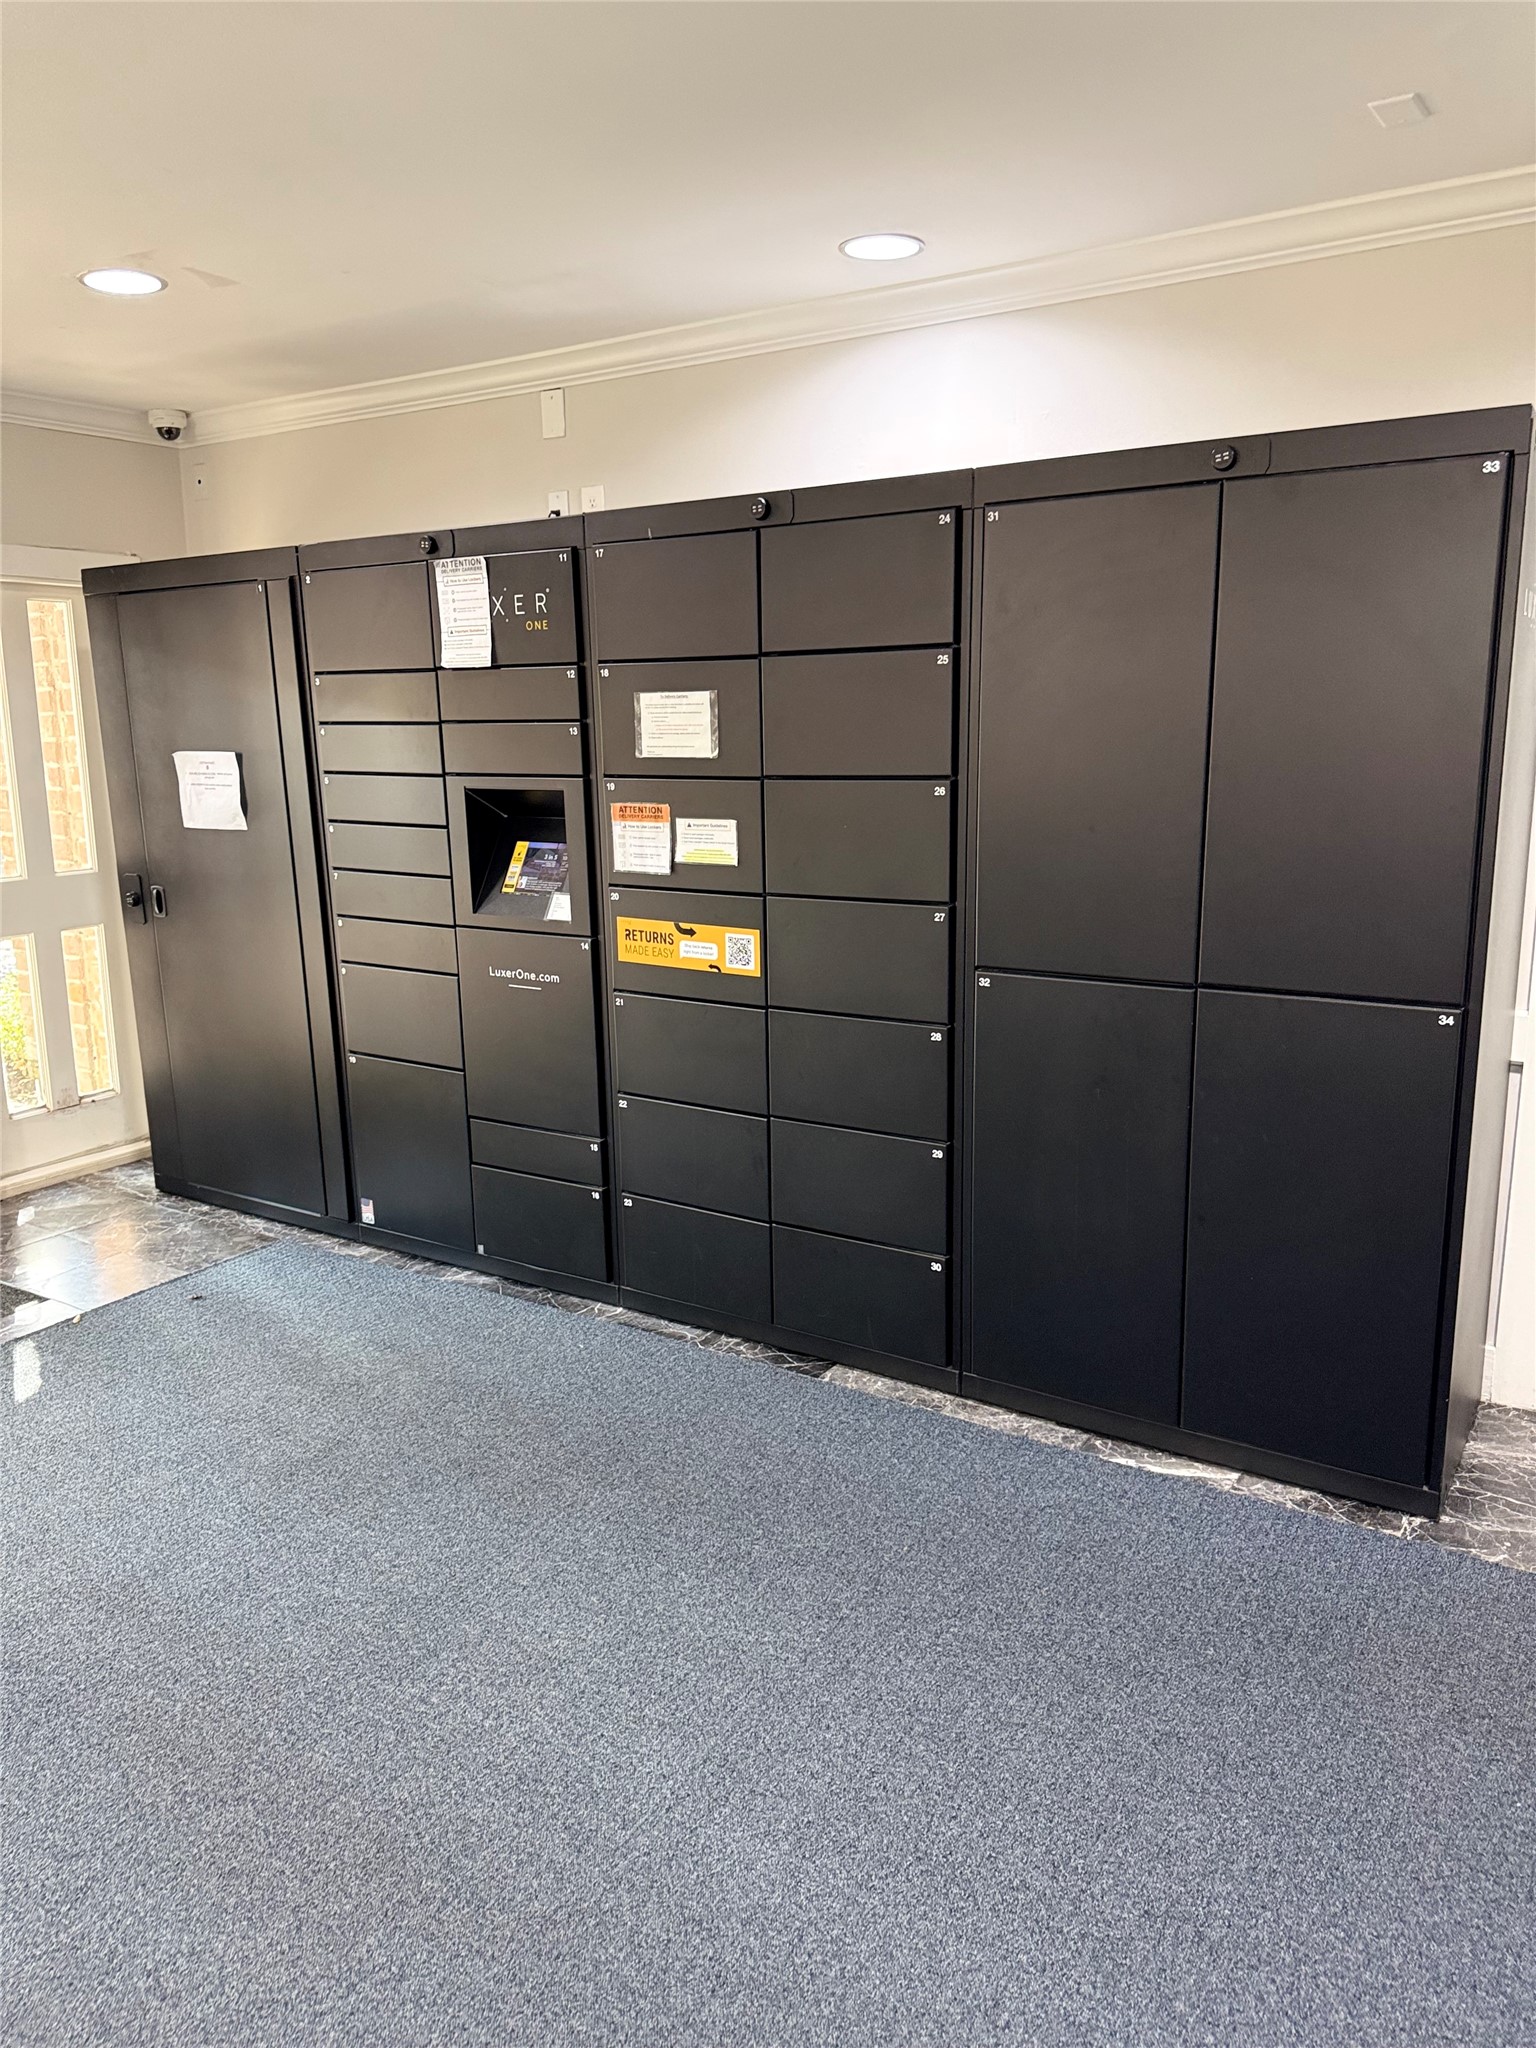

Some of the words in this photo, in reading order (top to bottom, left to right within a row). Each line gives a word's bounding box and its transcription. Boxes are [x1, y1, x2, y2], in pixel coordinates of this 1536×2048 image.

[1482, 460, 1501, 474] 33
[938, 513, 951, 525] 24
[987, 511, 999, 522] 31
[558, 553, 567, 562] 11
[595, 548, 604, 558] 17
[441, 557, 482, 569] ATTENTION
[305, 575, 311, 584] 2
[258, 584, 263, 593] 1
[491, 592, 548, 617] XER
[525, 619, 549, 631] ONE
[936, 654, 949, 665] 25
[566, 669, 576, 679] 12
[600, 668, 610, 678] 18
[320, 728, 325, 736] 4
[569, 726, 578, 736] 13
[606, 782, 615, 791] 19
[934, 786, 946, 796] 26
[618, 805, 663, 814] ATTENTION
[333, 872, 338, 880] 7
[610, 892, 620, 901] 20
[934, 912, 946, 922] 27
[624, 928, 675, 946] RETURNS
[580, 942, 589, 951] 14
[624, 944, 650, 956] MADE
[651, 946, 675, 959] EASY
[488, 965, 560, 984] LuxerOne.com
[978, 977, 991, 987] 32
[615, 997, 624, 1006] 21
[1438, 1014, 1455, 1026] 34
[930, 1032, 942, 1042] 28
[618, 1099, 628, 1108] 22
[589, 1143, 599, 1152] 15
[931, 1149, 943, 1159] 29
[623, 1198, 633, 1207] 23
[930, 1262, 942, 1272] 30
